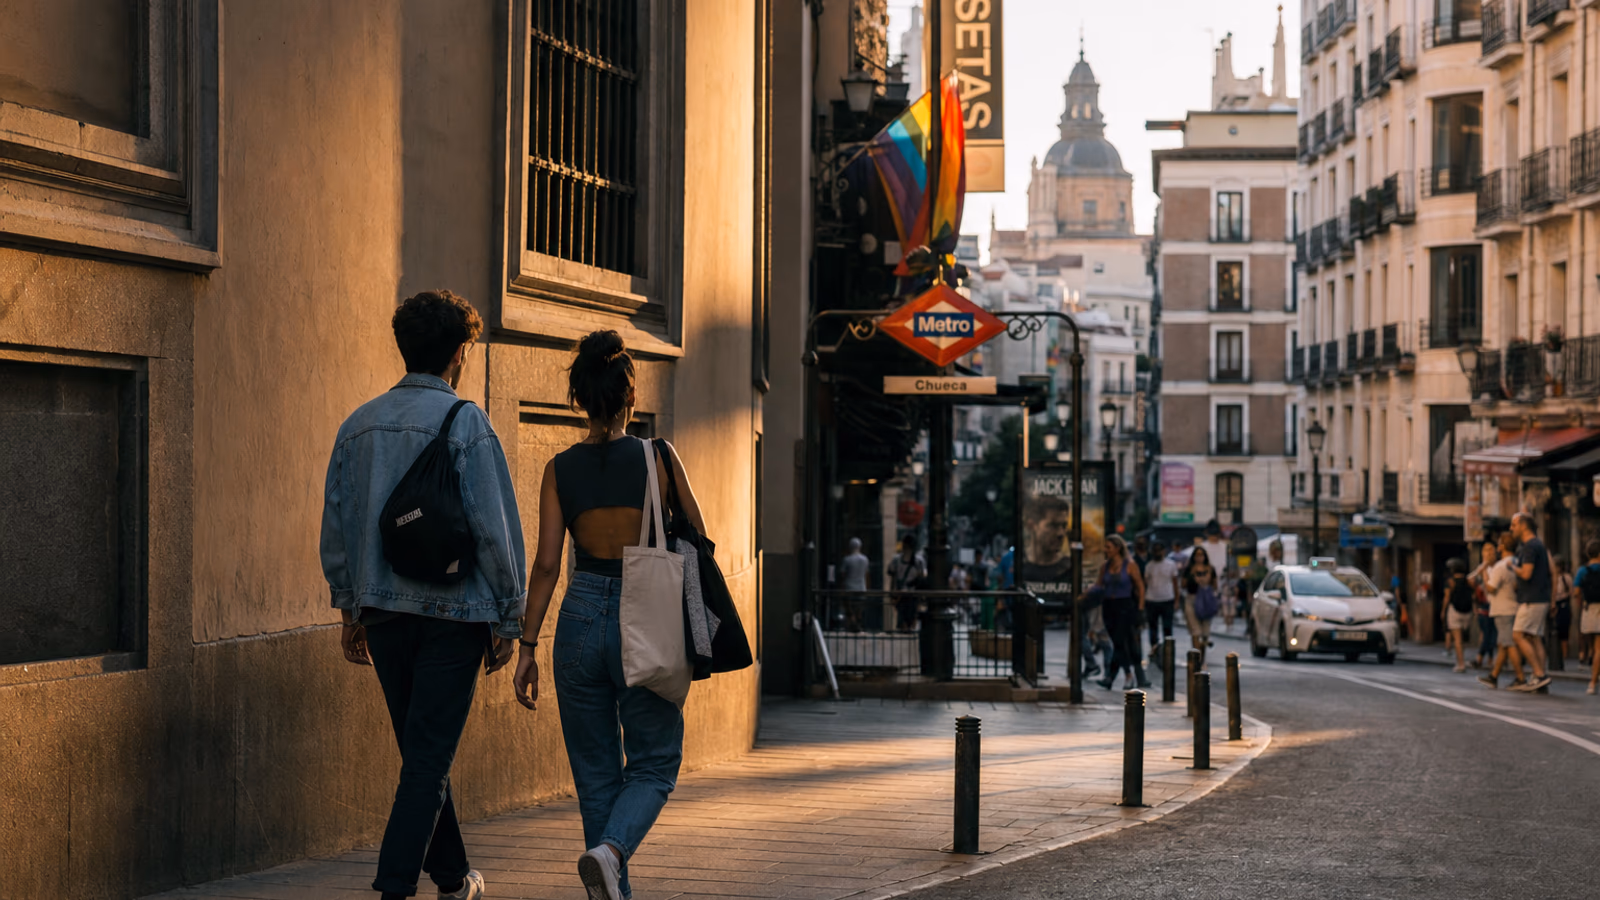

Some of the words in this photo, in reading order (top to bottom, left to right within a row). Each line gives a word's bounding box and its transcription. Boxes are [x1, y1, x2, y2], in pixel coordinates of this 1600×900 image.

[955, 0, 992, 130] SETAS
[918, 316, 971, 333] Metro
[915, 379, 968, 392] Chueca
[1032, 479, 1063, 495] JACK
[1065, 479, 1098, 495] RAN
